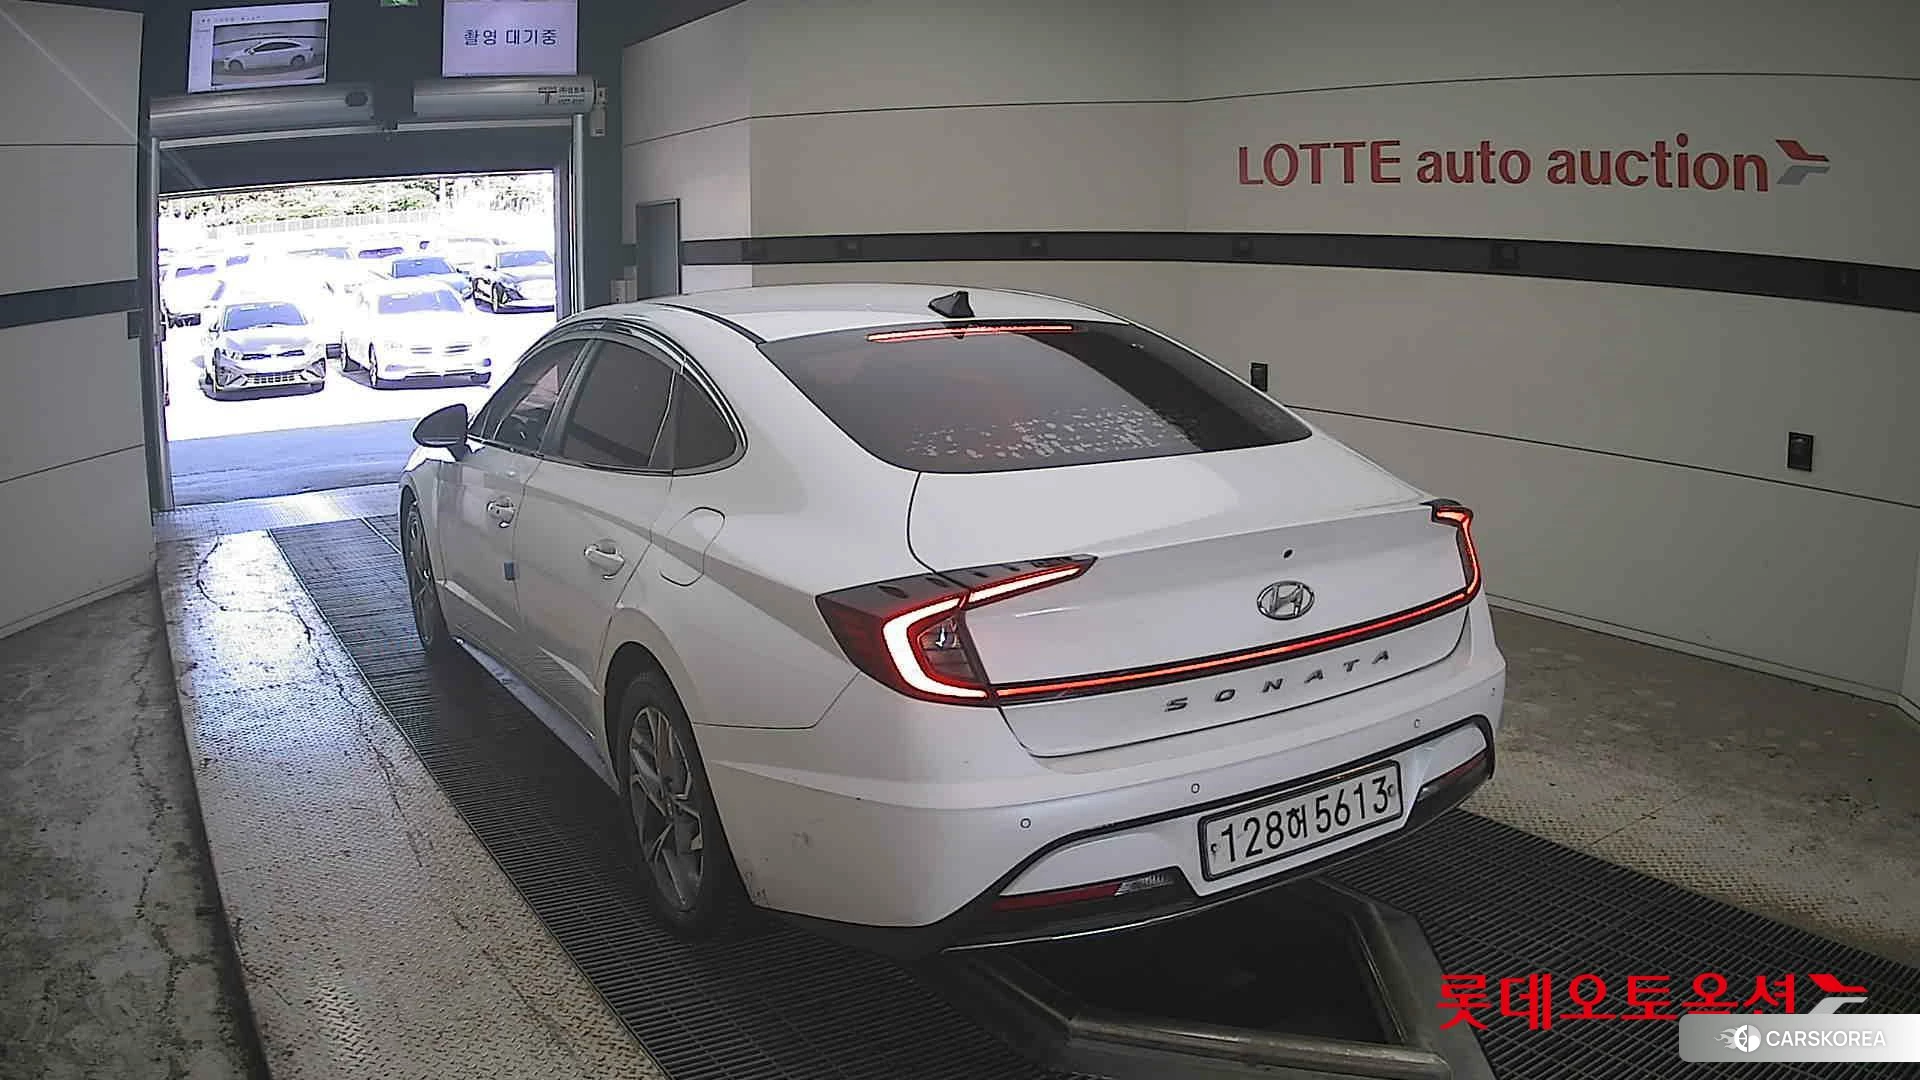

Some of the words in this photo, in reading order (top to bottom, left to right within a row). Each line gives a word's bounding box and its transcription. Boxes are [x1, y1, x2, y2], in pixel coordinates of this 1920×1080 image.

[464, 29, 497, 46] 촬영
[505, 29, 557, 46] 대기중
[1238, 140, 1401, 186] LOTTE
[1415, 140, 1531, 185] auto
[1546, 132, 1769, 193] auction
[1165, 650, 1389, 712] SONATA
[1221, 775, 1389, 863] 128허5613
